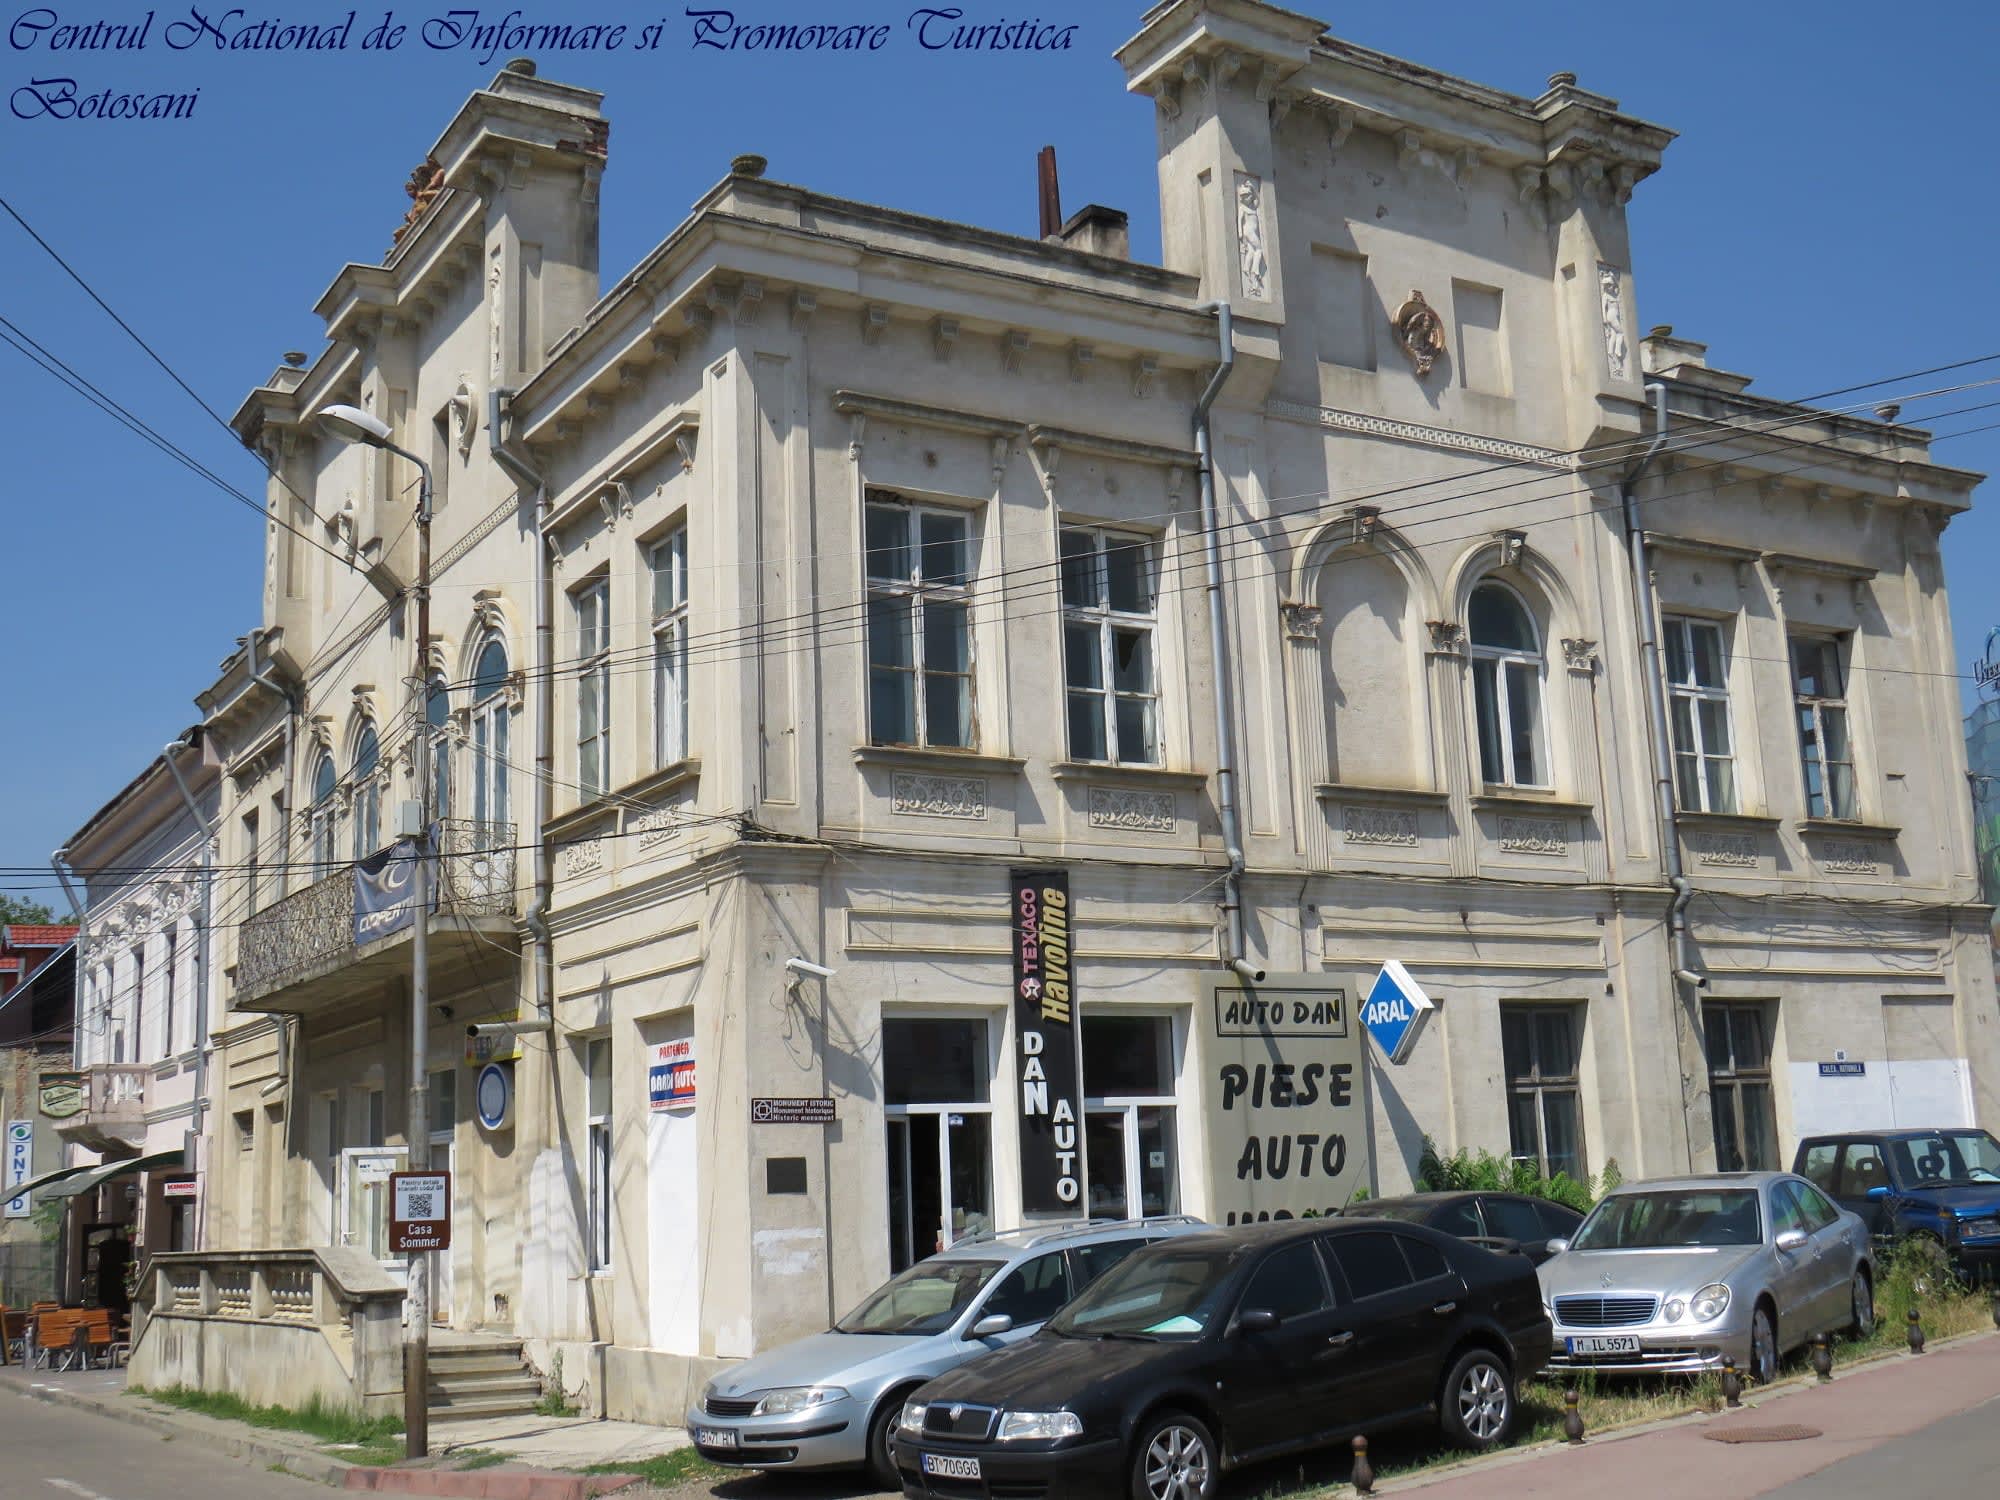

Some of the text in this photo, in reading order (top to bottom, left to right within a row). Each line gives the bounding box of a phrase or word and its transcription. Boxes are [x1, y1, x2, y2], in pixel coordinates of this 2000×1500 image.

[1020, 888, 1038, 974] TEXACO
[1039, 887, 1070, 1024] Havoline
[1225, 999, 1341, 1025] AUTO DAN
[1367, 999, 1410, 1026] ARAL
[1024, 1031, 1048, 1115] DAN
[1220, 1063, 1353, 1111] PIESE
[805, 1107, 834, 1115] historique
[1053, 1099, 1078, 1202] AUTO
[1237, 1134, 1347, 1180] AUTO
[13, 1144, 26, 1211] PNTD
[400, 1237, 440, 1248] Sommer
[408, 1224, 432, 1235] Casa
[1576, 1339, 1584, 1351] M
[1607, 1338, 1635, 1351] 5571
